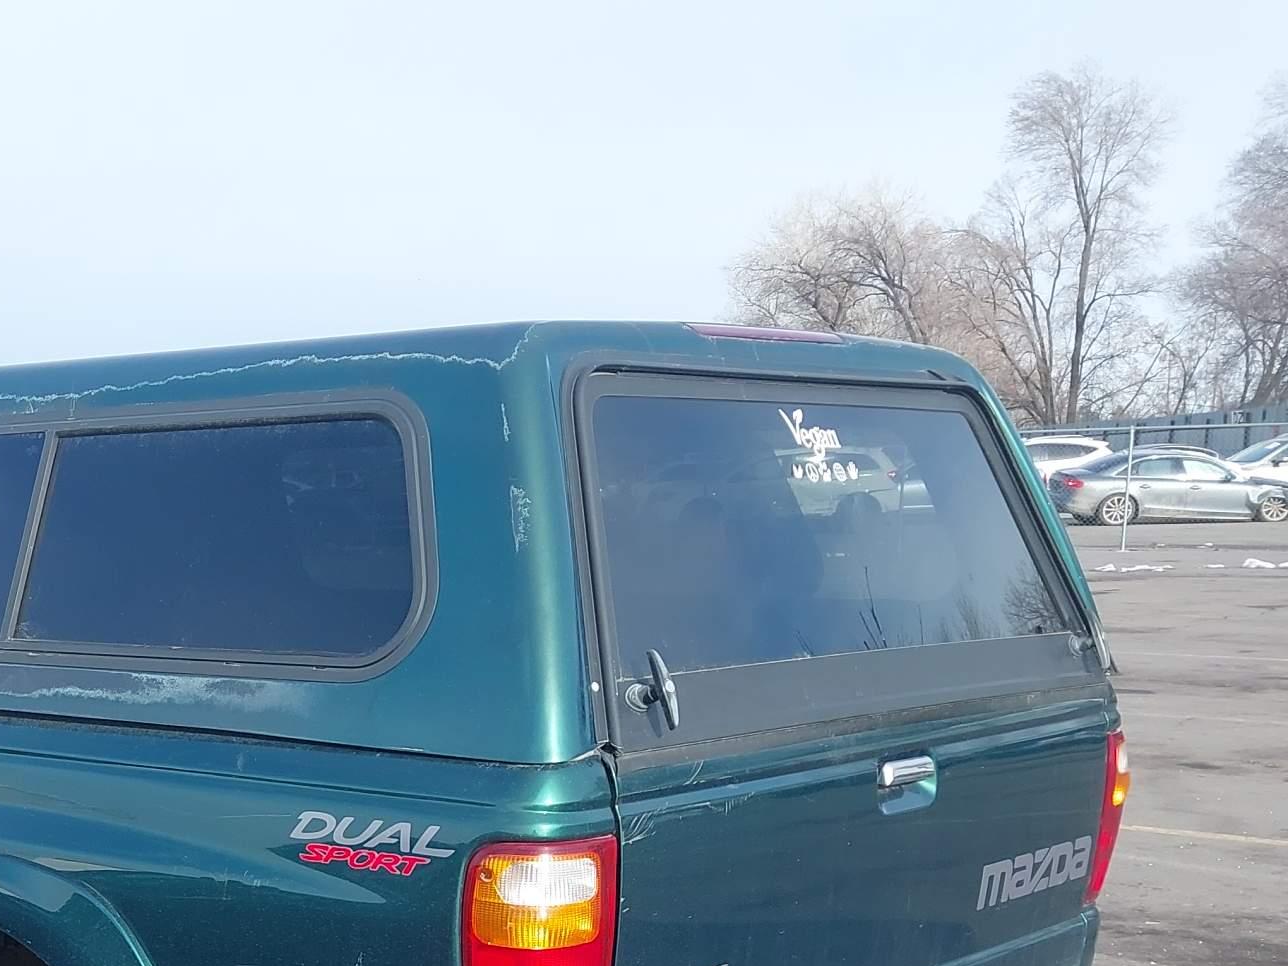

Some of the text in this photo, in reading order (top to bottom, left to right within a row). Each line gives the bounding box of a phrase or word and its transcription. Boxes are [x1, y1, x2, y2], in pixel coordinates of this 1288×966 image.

[778, 408, 842, 462] Vegan
[289, 810, 456, 858] DUAL
[299, 842, 432, 877] SPORT
